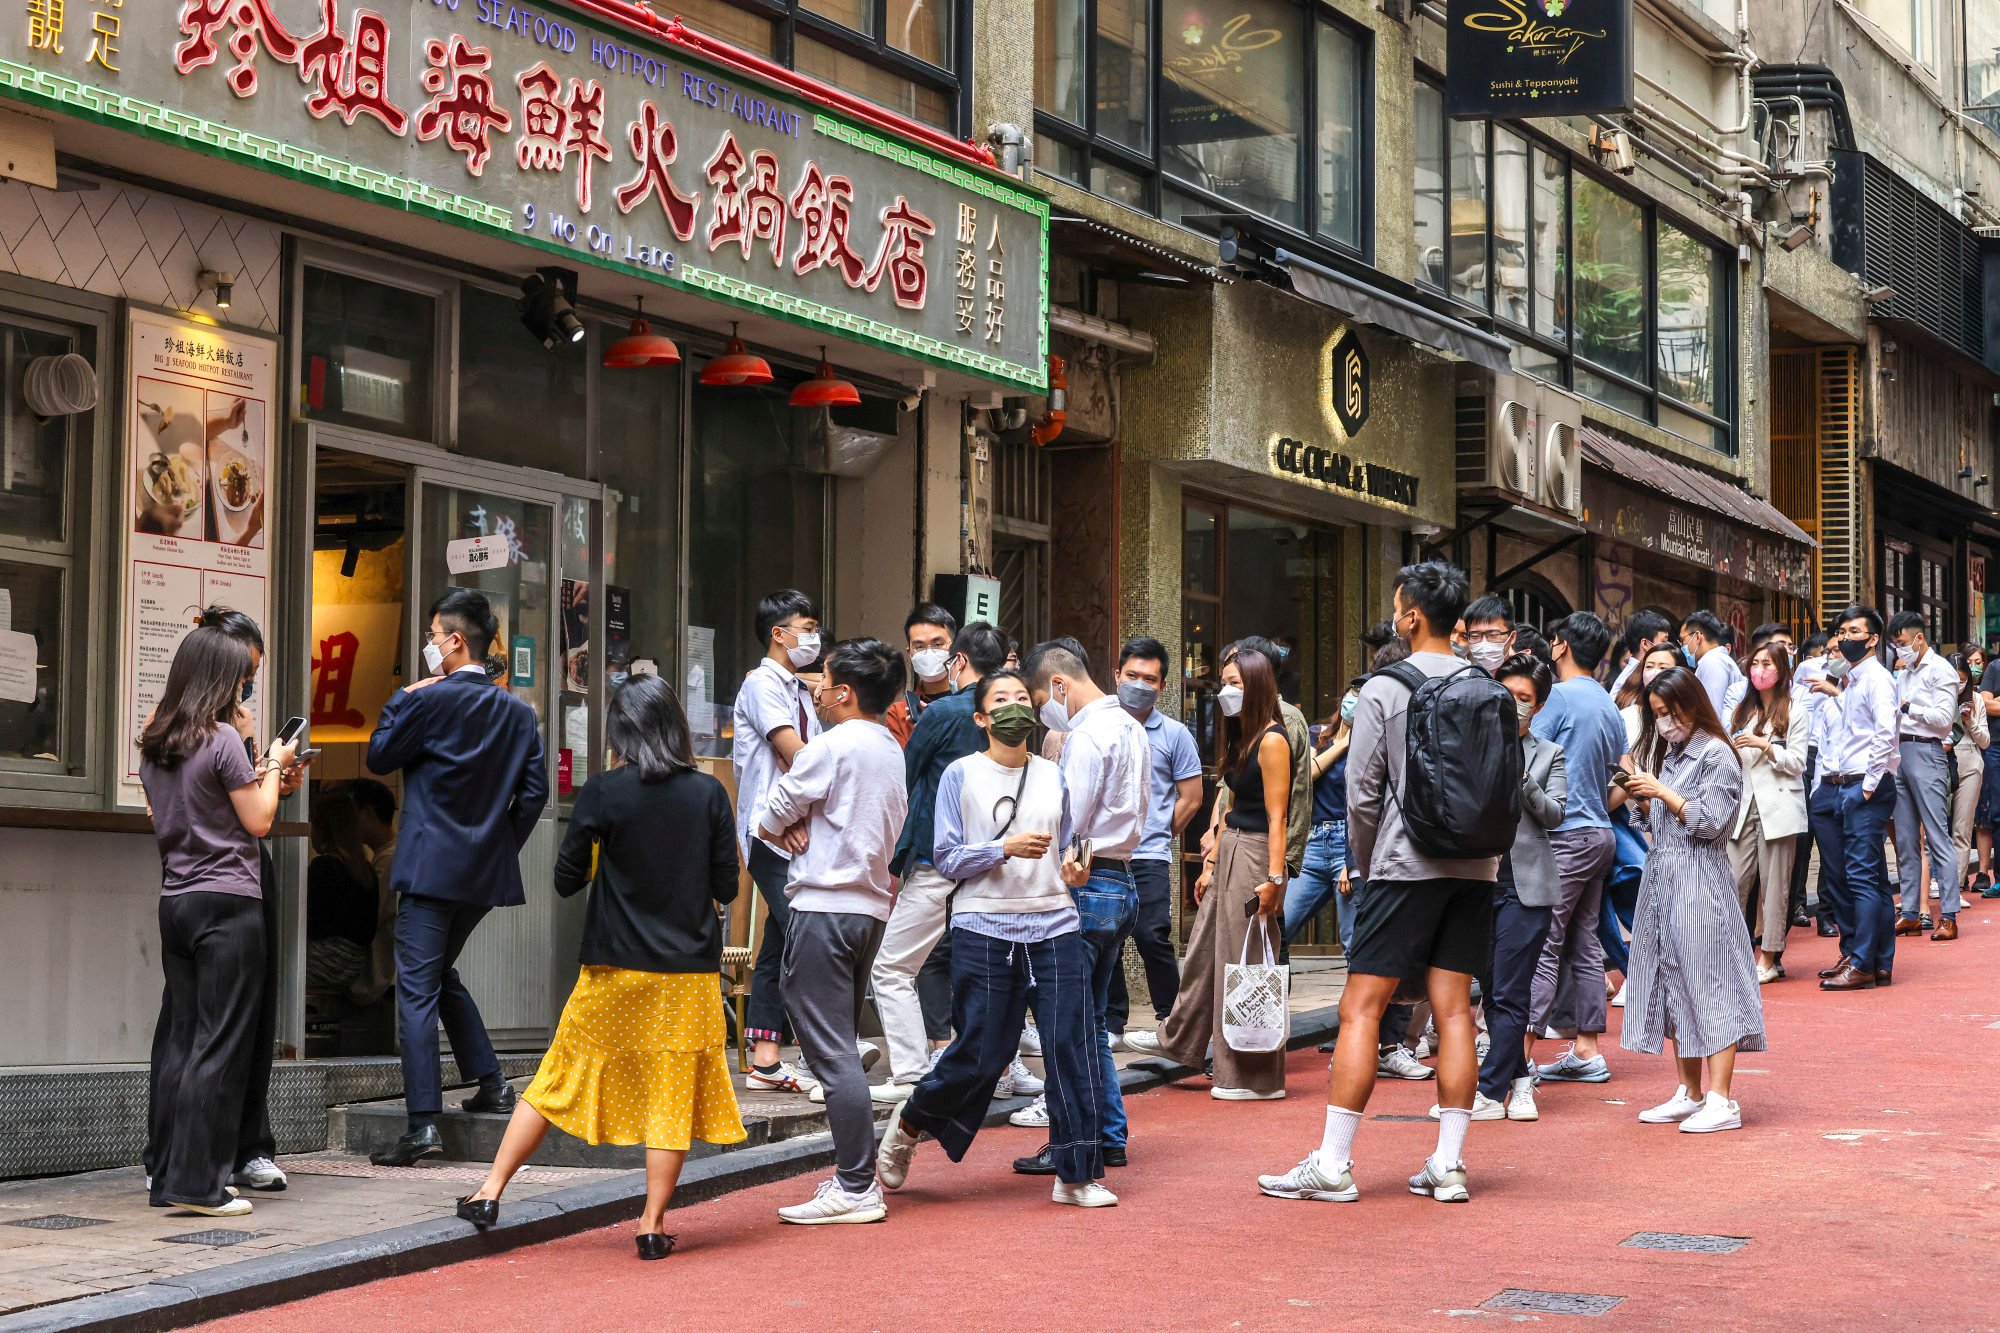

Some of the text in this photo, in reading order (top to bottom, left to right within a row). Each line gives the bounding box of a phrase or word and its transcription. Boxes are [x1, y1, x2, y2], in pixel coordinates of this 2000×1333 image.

[84, 0, 123, 71] 足
[1463, 0, 1606, 47] Sakura
[475, 0, 803, 139] SEAFOOD HOTPOT RESTAURANT
[1490, 77, 1580, 90] Sushi & Teppanyaki
[174, 0, 937, 312] 珍姐海鮮火鍋飯店
[522, 203, 675, 272] 9 Wo On Lane
[955, 202, 977, 334] 服務妥
[985, 214, 1006, 343] 人品好
[154, 354, 164, 364] BIG
[172, 357, 197, 370] SEAFOOD
[198, 363, 220, 375] HOTPOT
[221, 368, 254, 382] RESTAURANT
[164, 336, 245, 368] 珍姐海鮮火鍋飯店
[1668, 509, 1704, 545] 高山民藝
[1660, 532, 1710, 566] Mountain Folkcraft
[976, 592, 989, 616] E
[1235, 982, 1268, 1011] Breathe
[1240, 991, 1271, 1018] Deeply
